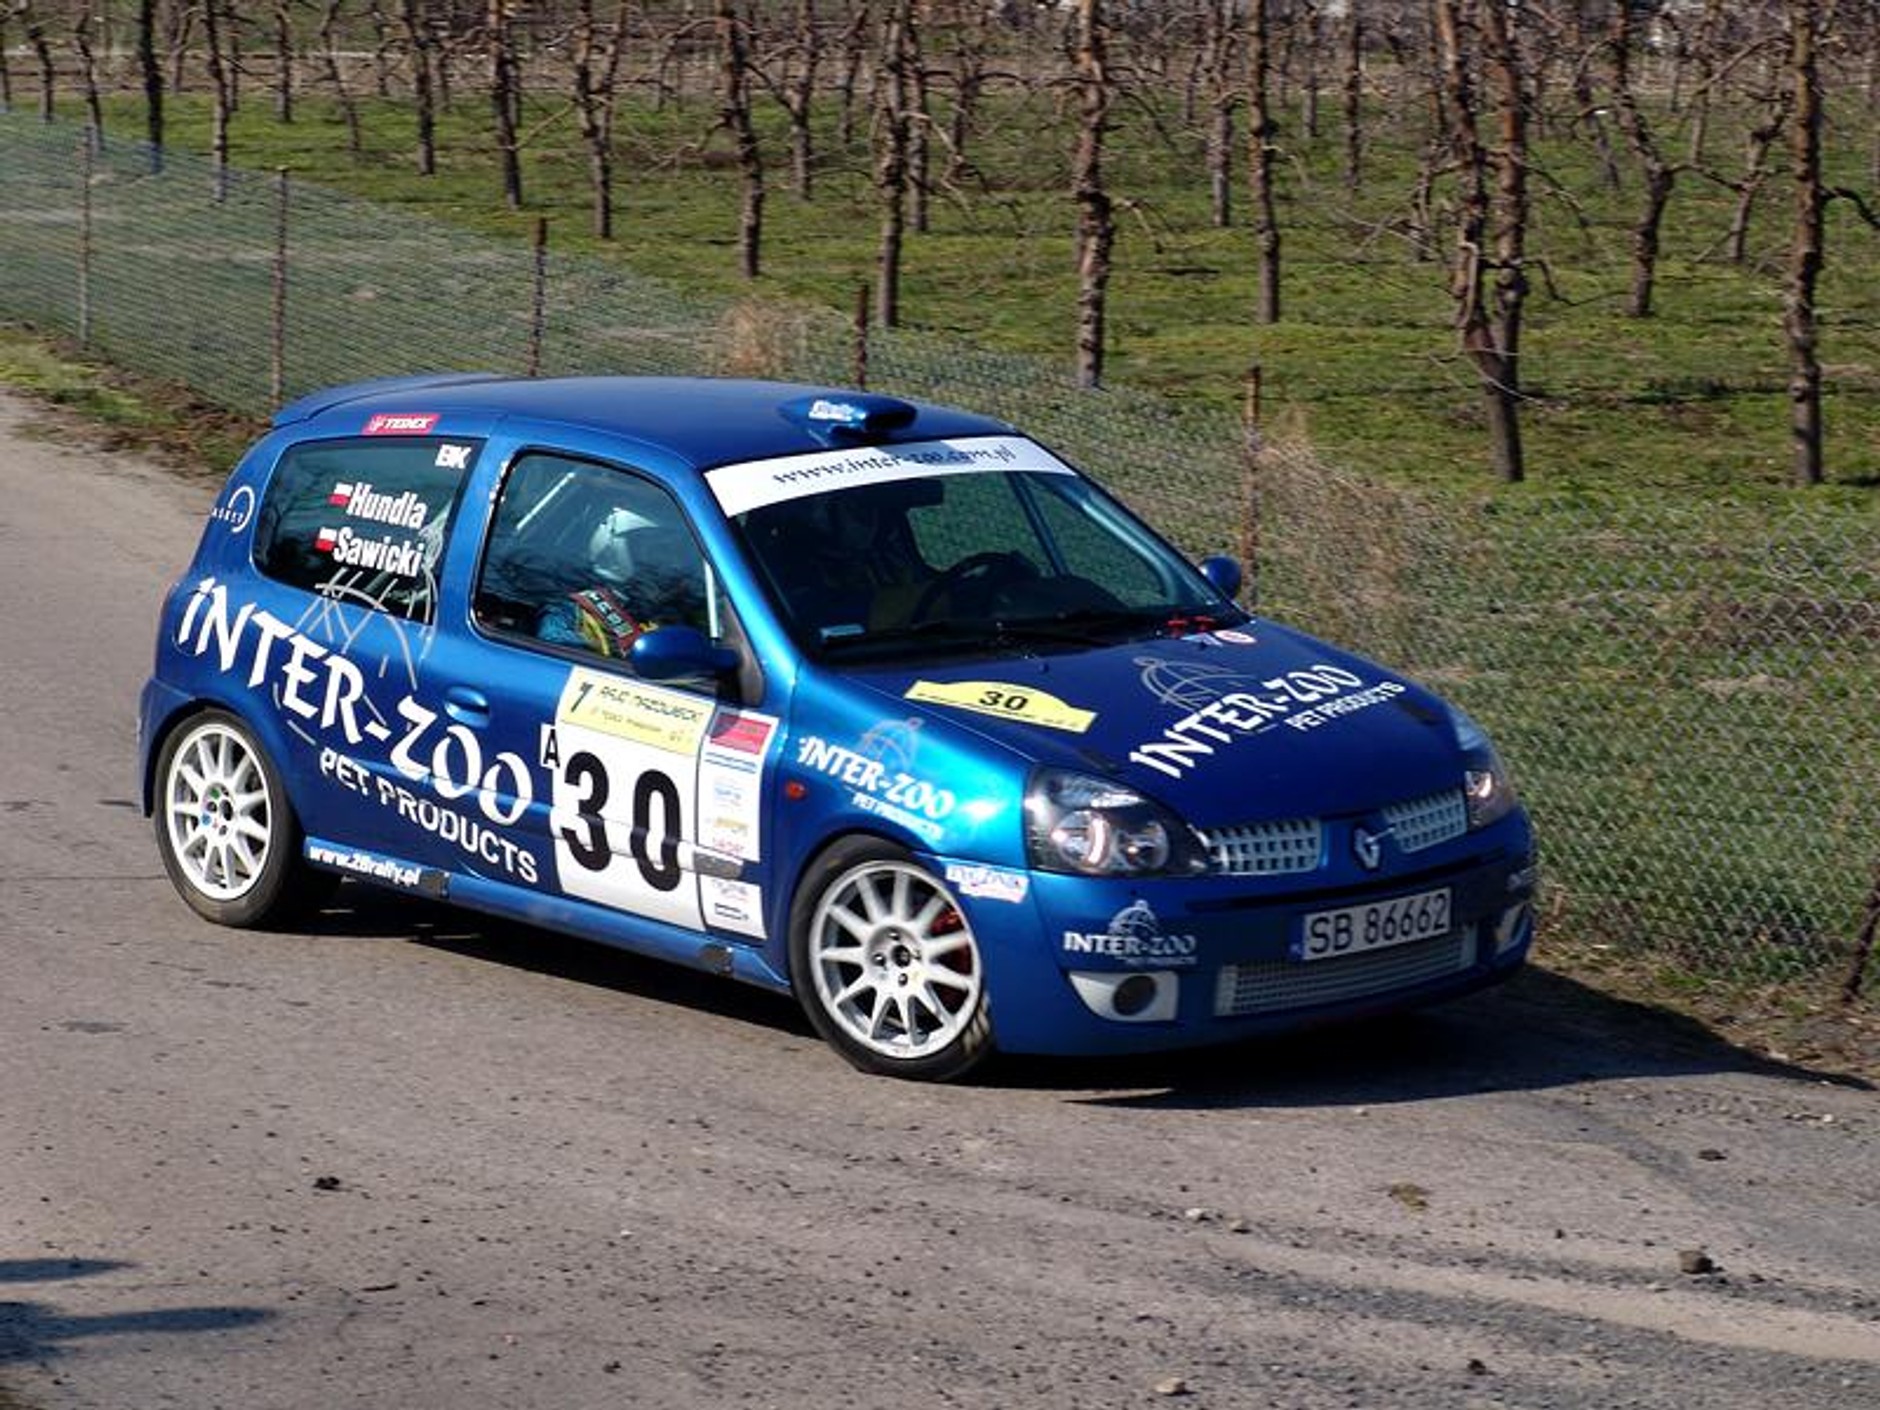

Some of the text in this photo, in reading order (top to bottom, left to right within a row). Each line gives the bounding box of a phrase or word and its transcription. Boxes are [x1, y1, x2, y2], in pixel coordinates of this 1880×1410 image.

[345, 482, 428, 530] Hundla
[332, 527, 425, 578] Sawicki
[978, 690, 1029, 711] 30
[1129, 664, 1363, 779] INTER-ZOO
[543, 728, 561, 768] A
[796, 736, 955, 820] INTER-ZOO
[319, 747, 538, 884] PET PRODUCTS
[560, 751, 682, 892] 30
[1063, 930, 1197, 956] INTER-ZOO
[1310, 893, 1447, 954] SB 86662
